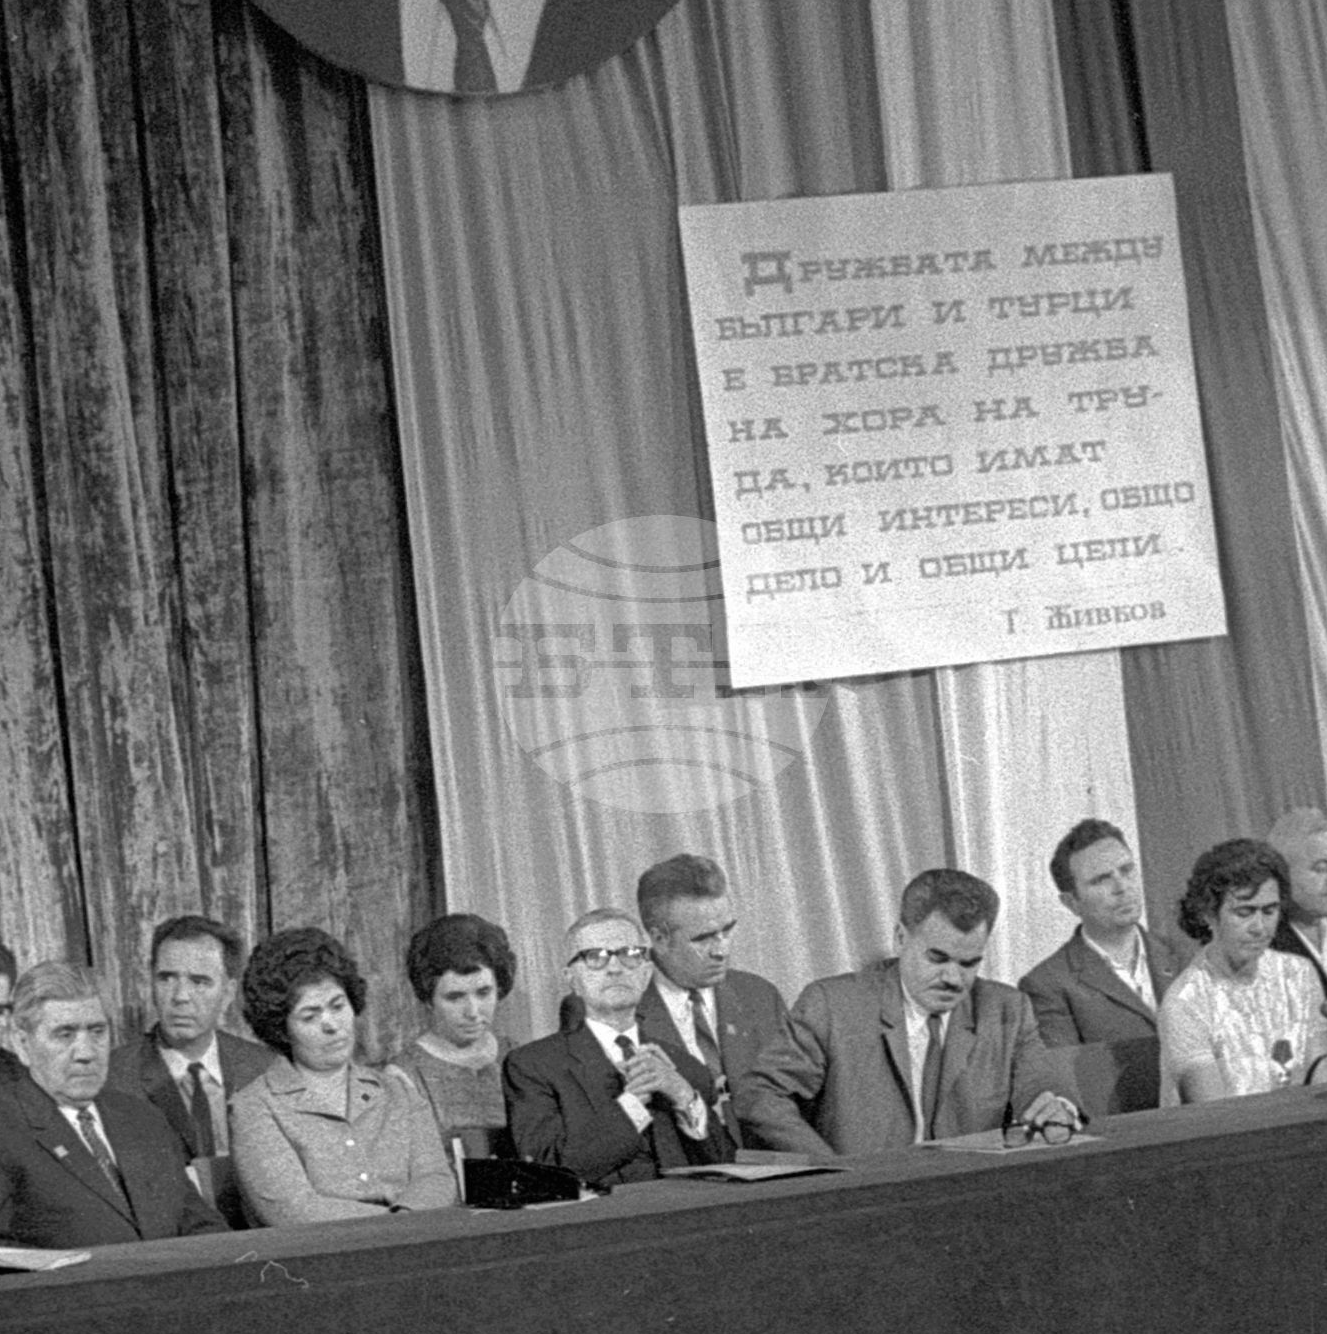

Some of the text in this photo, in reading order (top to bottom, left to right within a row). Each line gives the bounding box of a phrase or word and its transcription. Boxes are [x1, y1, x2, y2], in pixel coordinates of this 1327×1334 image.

[1022, 234, 1164, 268] МЕЖДУ
[932, 300, 967, 325] И
[988, 286, 1136, 321] ТУРЦИ
[722, 335, 1162, 392] Е БРАТСКА ДРУЖБА
[728, 384, 1164, 443] НА ХОРА НА ТРУ-
[734, 439, 1106, 501] ДА, КОИТО ИМАТ
[741, 481, 1196, 545] ОБЩИ ИНТЕРЕСИ, ОБЩО
[746, 567, 843, 604] ДЕЛО
[861, 561, 892, 586] И
[918, 548, 1030, 580] ОБЩИ
